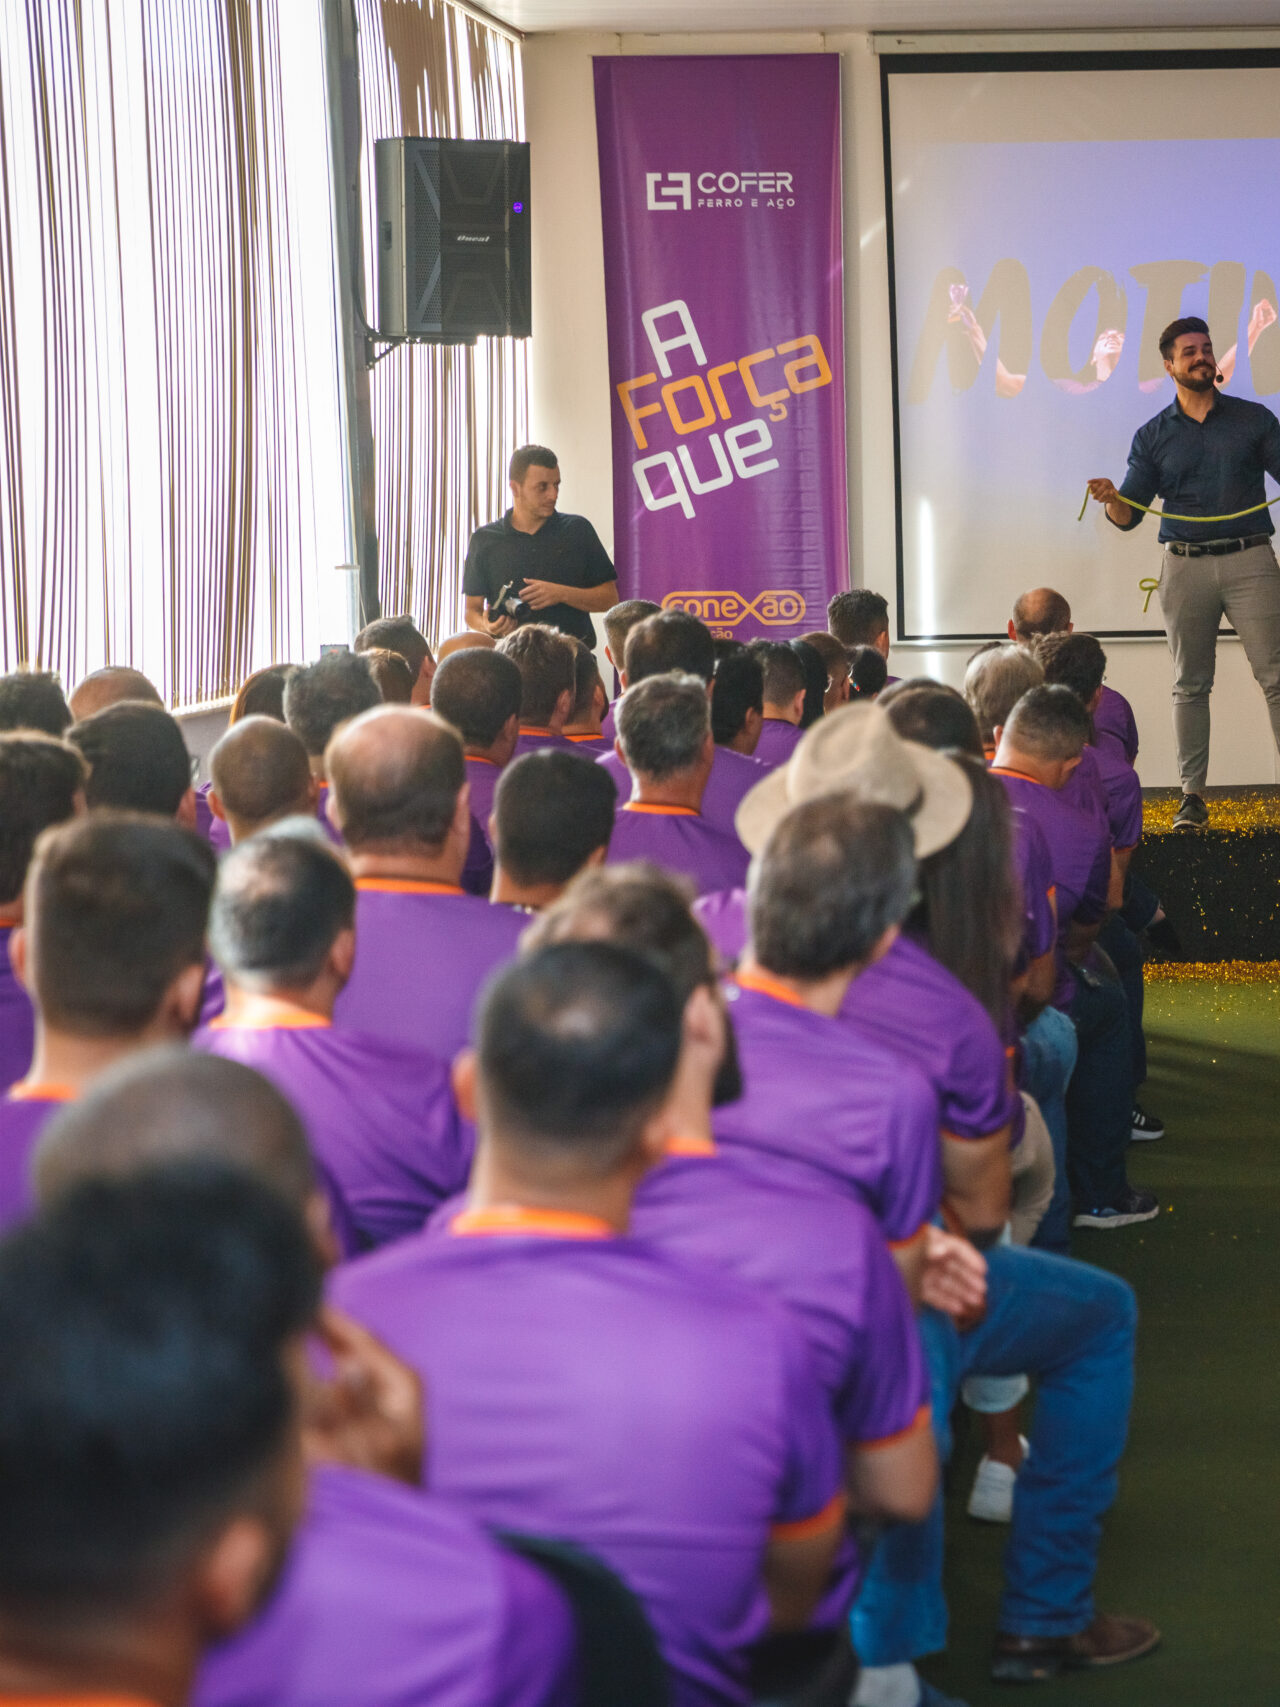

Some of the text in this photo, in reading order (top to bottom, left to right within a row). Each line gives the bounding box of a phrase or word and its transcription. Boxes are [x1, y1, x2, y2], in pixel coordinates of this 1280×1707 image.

[697, 172, 794, 193] COFER
[697, 198, 795, 209] FERRO E AÇO
[641, 299, 708, 379] A
[616, 334, 833, 450] Força
[632, 418, 780, 520] que
